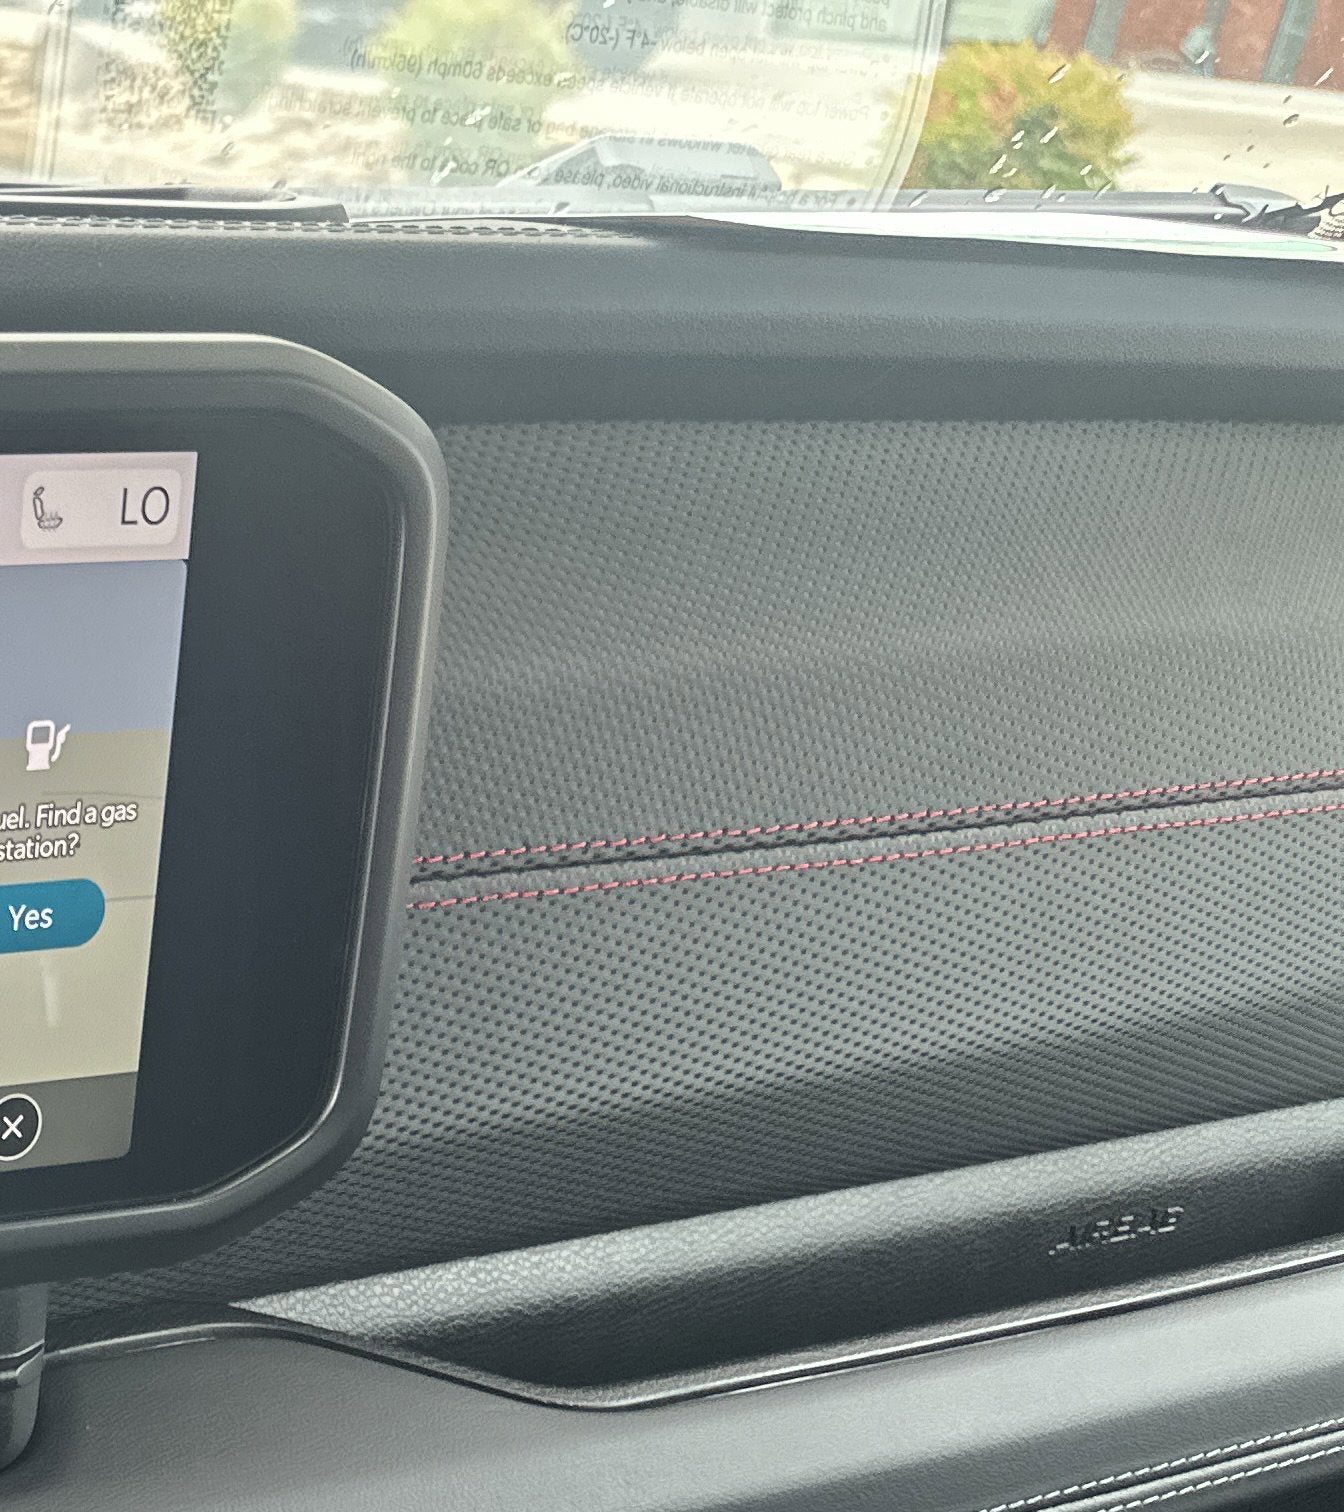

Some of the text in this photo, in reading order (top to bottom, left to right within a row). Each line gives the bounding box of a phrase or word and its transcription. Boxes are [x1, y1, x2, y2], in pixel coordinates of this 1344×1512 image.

[120, 486, 170, 528] LO
[35, 800, 81, 828] Find
[84, 807, 99, 826] a
[100, 801, 139, 829] gas
[8, 904, 54, 932] Yes
